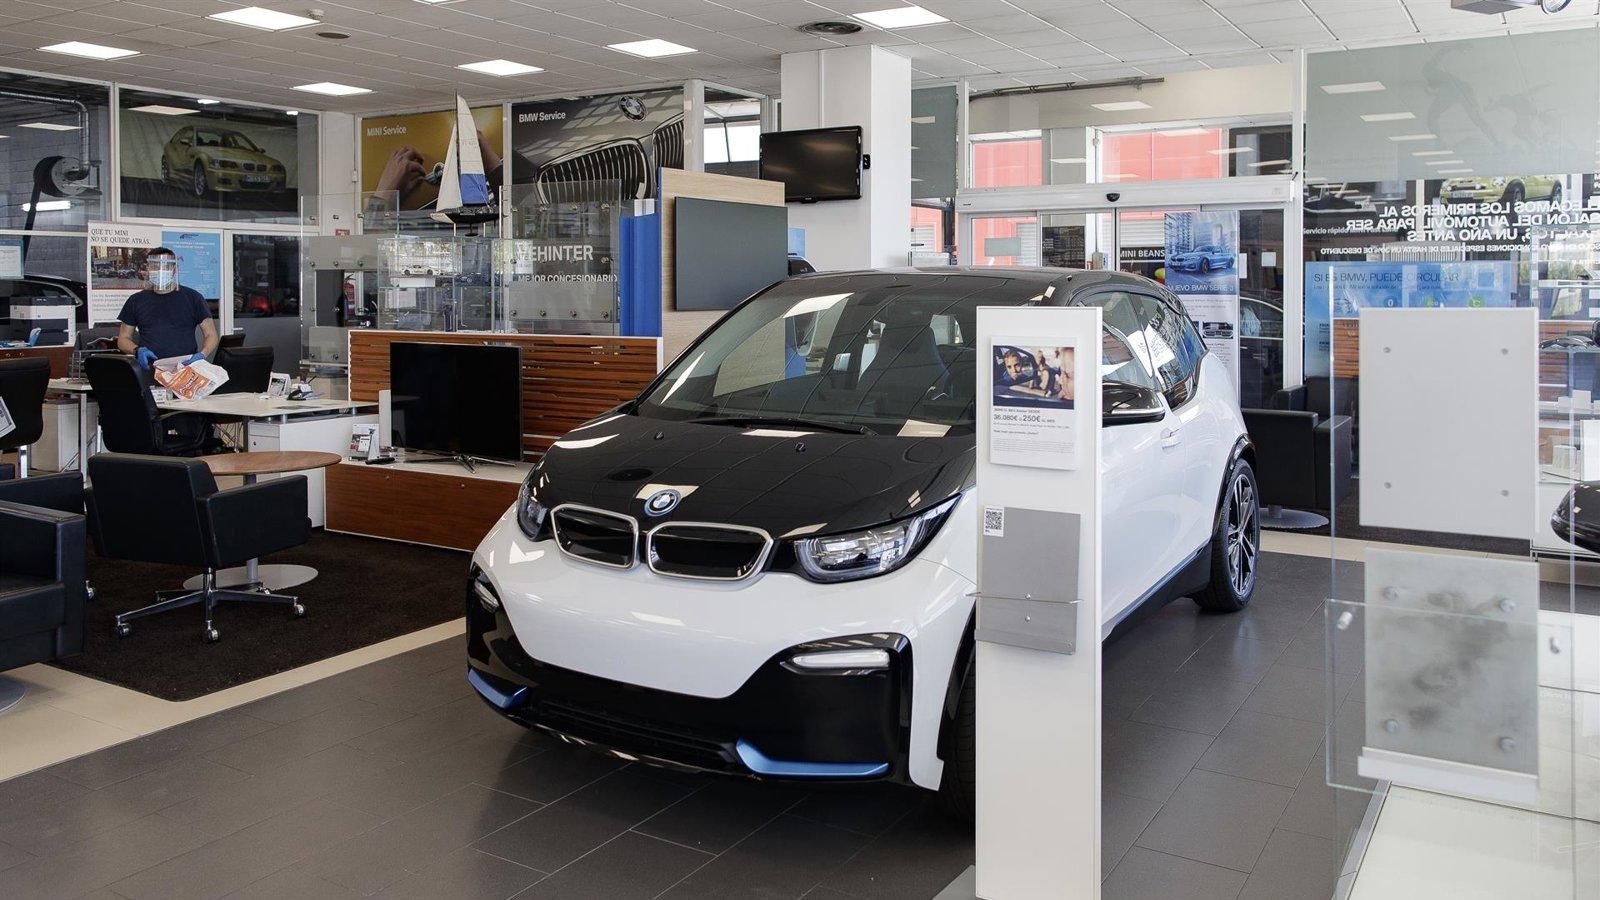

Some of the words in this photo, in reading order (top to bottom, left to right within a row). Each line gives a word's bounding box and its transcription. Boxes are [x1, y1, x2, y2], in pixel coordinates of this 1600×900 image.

[519, 112, 539, 123] BMW
[539, 110, 566, 122] Service
[367, 127, 382, 137] MINI
[383, 125, 407, 136] Service
[90, 228, 103, 236] QUE
[115, 229, 128, 237] MINI
[1138, 249, 1165, 257] BEANS
[547, 274, 618, 282] CONCESIONARIO
[1314, 273, 1323, 282] SI
[1340, 272, 1367, 283] BMW,
[1370, 272, 1402, 282] PUEDE
[1406, 271, 1459, 282] CIRCULAR
